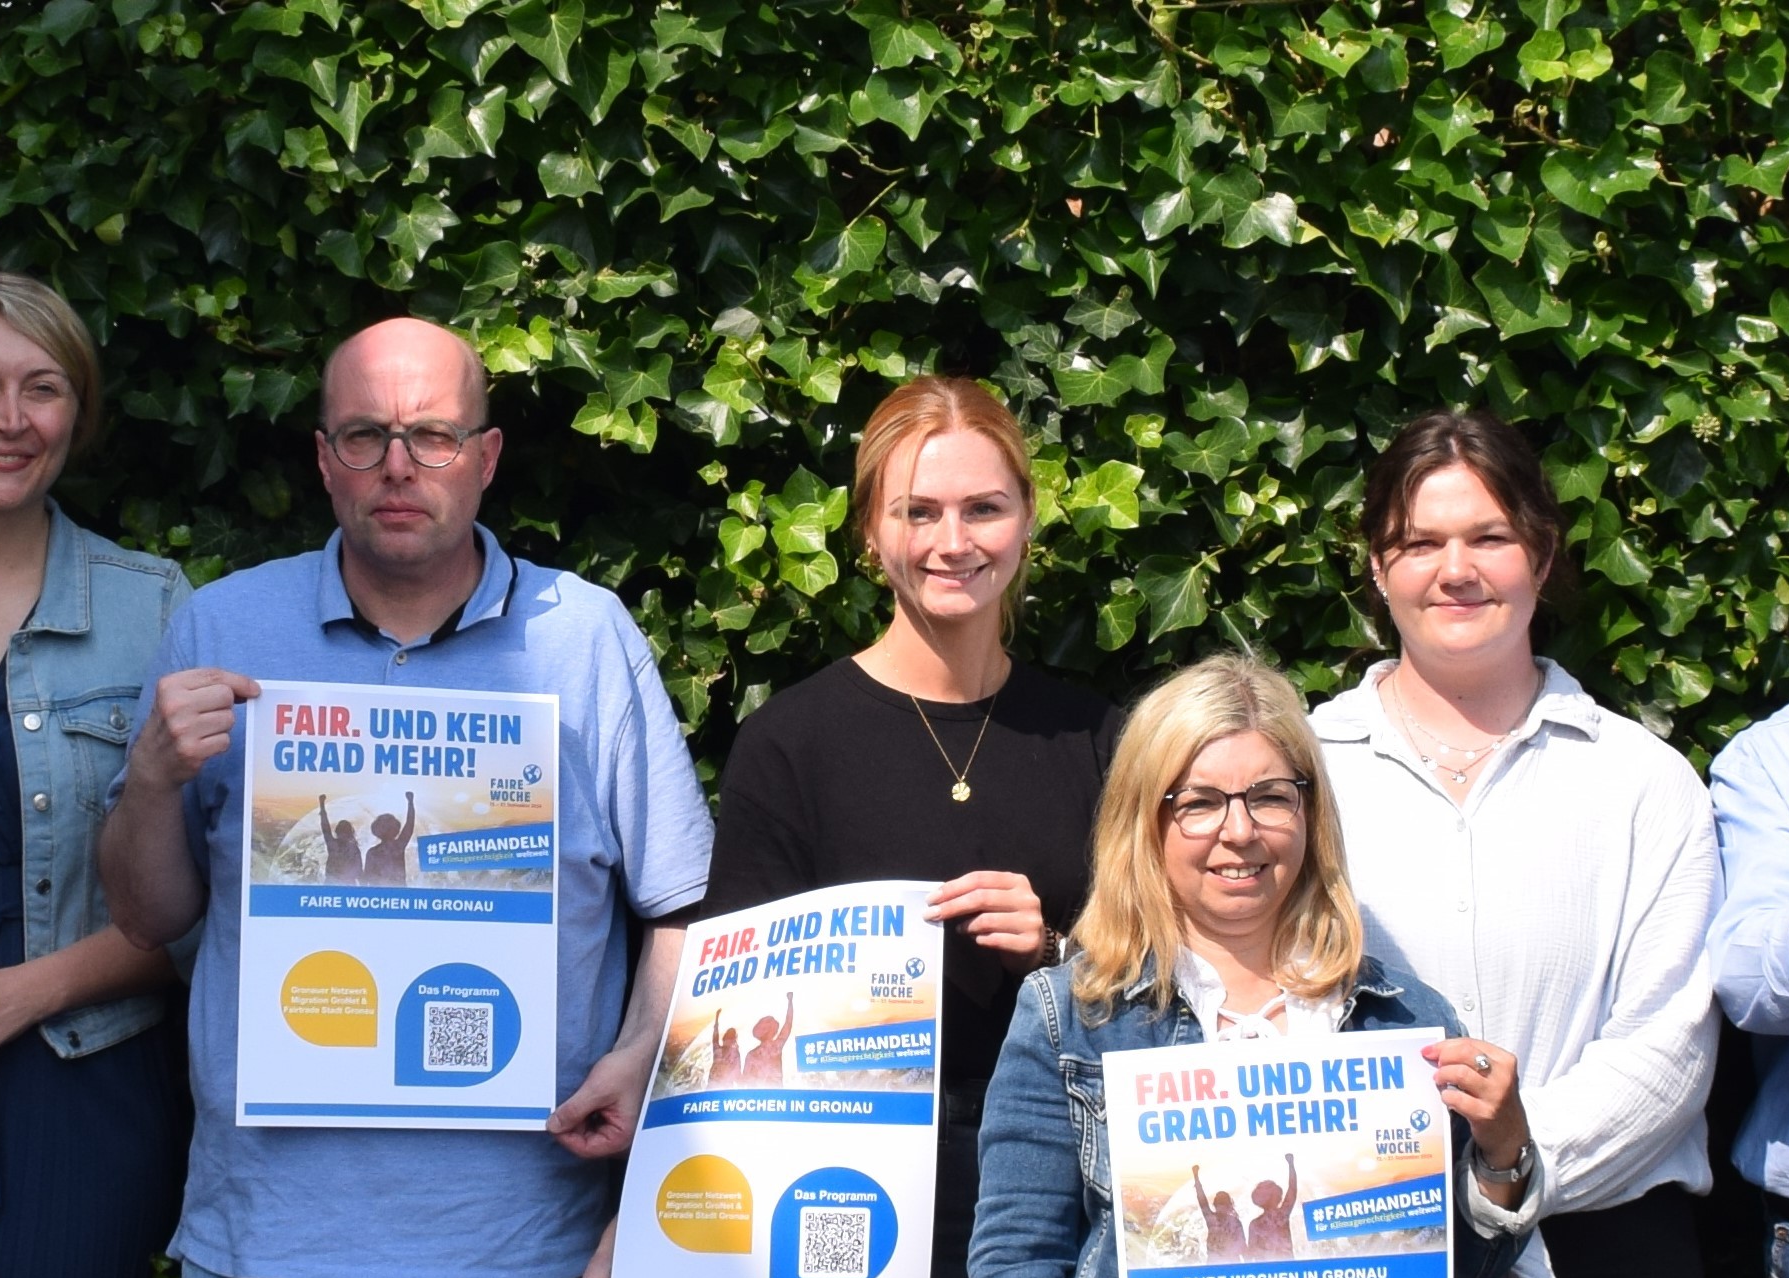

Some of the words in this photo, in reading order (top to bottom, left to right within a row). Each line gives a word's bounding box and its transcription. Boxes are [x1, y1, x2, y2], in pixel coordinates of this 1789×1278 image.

[276, 704, 360, 737] FAIR.
[370, 708, 436, 740] UND
[447, 712, 521, 745] KEIN
[274, 740, 364, 773] GRAD
[374, 744, 476, 778] MEHR!
[491, 778, 523, 789] FAIRE
[491, 791, 531, 802] WOCHE
[427, 835, 549, 855] #FAIRHANDELN
[300, 896, 341, 907] FAIRE
[346, 897, 409, 910] WOCHEN
[414, 899, 427, 910] IN
[432, 900, 493, 912] GRONAU
[699, 927, 759, 967] FAIR.
[767, 911, 822, 947] UND
[830, 905, 904, 937] KEIN
[692, 956, 758, 998] GRAD
[763, 943, 856, 979] MEHR!
[871, 973, 905, 985] FAIRE
[418, 985, 440, 995] Das
[442, 985, 499, 998] Programm
[871, 986, 912, 998] WOCHE
[805, 1033, 931, 1055] #FAIRHANDELN
[1135, 1068, 1229, 1106] FAIR.
[1237, 1061, 1312, 1098] UND
[1322, 1055, 1404, 1093] KEIN
[683, 1100, 719, 1114] FAIRE
[723, 1099, 786, 1112] WOCHEN
[791, 1101, 805, 1112] IN
[809, 1101, 873, 1114] GRONAU
[1137, 1105, 1236, 1144] GRAD
[1247, 1098, 1359, 1137] MEHR!
[1376, 1128, 1411, 1141] FAIRE
[1376, 1141, 1420, 1155] WOCHE
[794, 1189, 816, 1200] Das
[819, 1190, 877, 1203] Programm
[1313, 1188, 1442, 1222] #FAIRHANDELN
[1316, 1223, 1328, 1231] für
